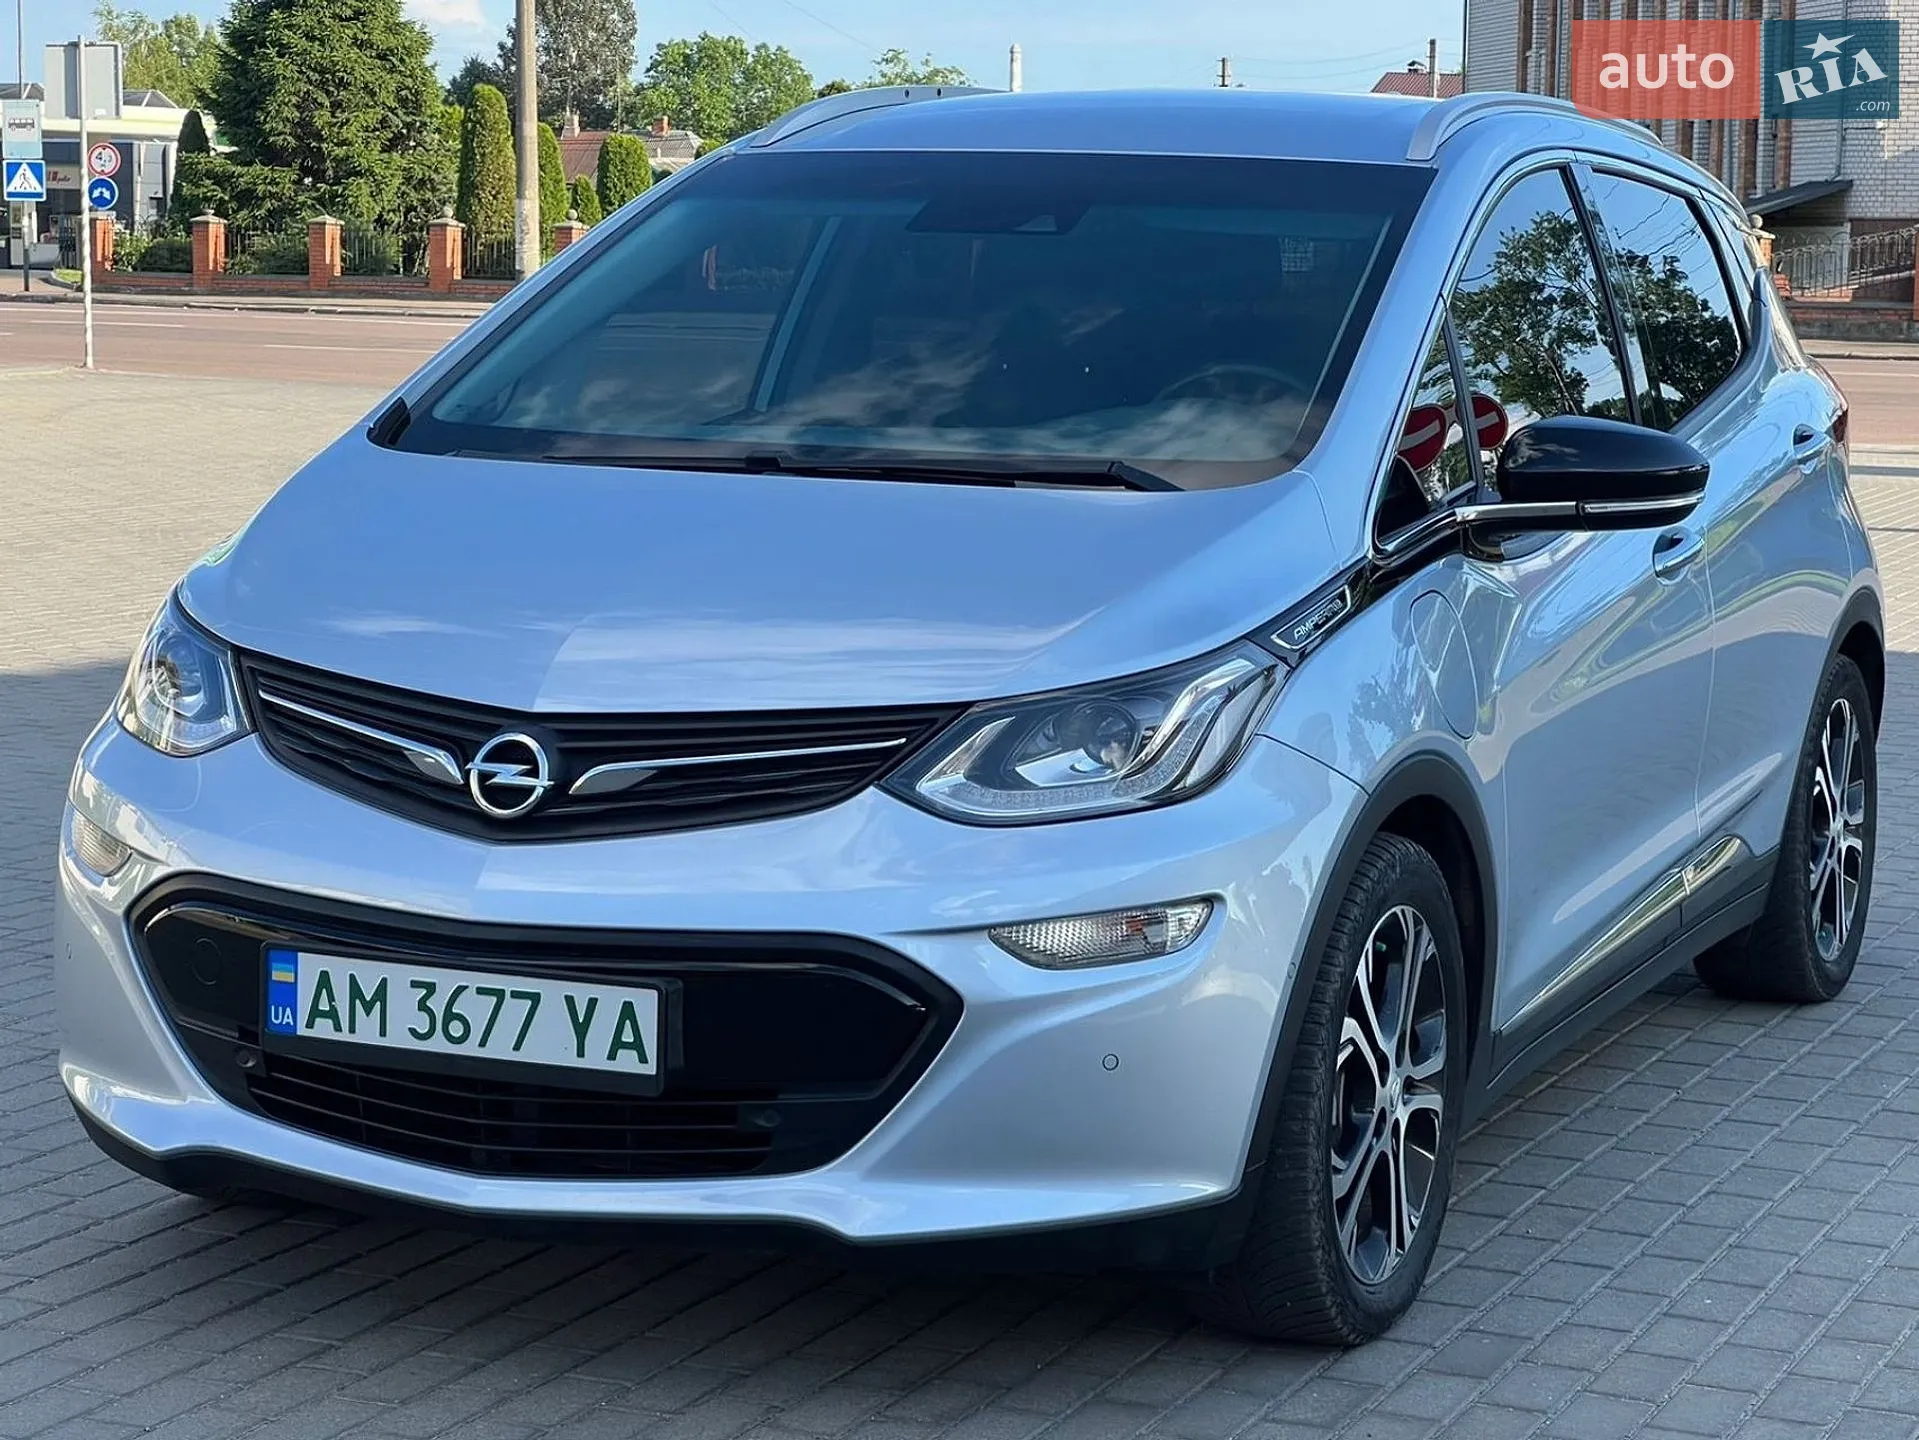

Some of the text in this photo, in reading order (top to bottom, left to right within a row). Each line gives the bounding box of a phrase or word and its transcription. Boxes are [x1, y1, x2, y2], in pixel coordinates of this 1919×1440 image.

[270, 1005, 294, 1027] UA
[304, 969, 650, 1065] AM 3677 YA
